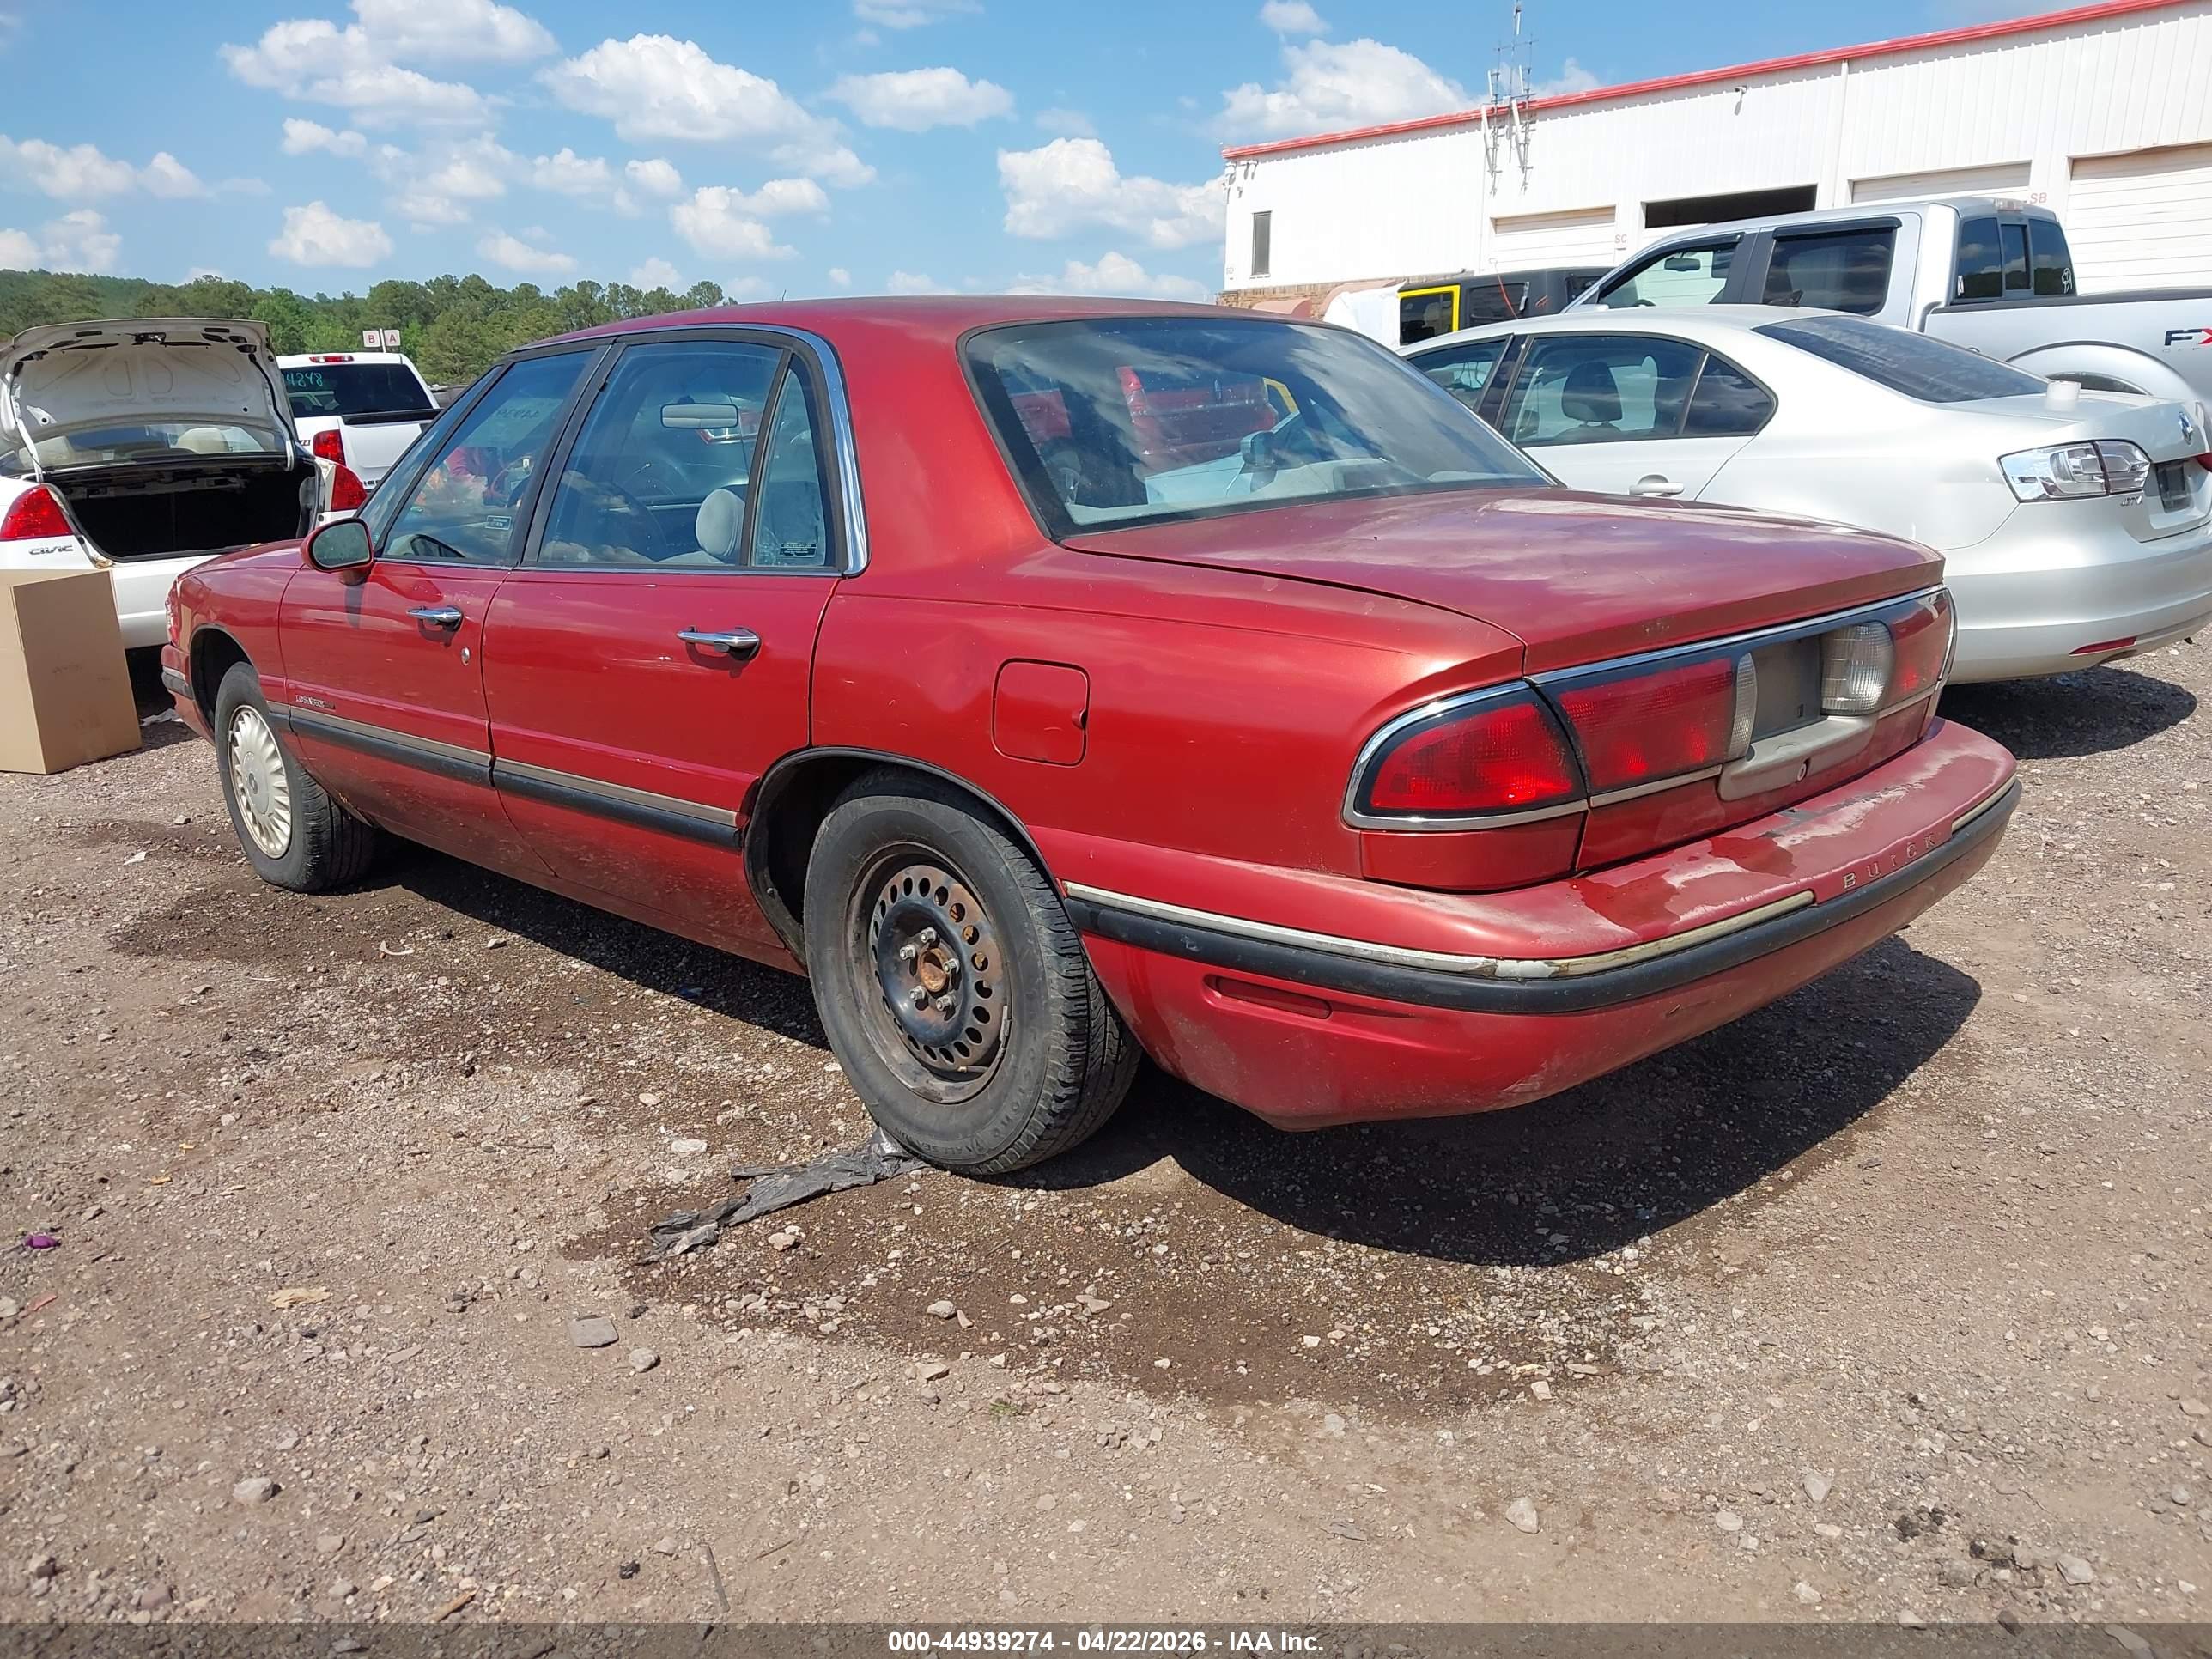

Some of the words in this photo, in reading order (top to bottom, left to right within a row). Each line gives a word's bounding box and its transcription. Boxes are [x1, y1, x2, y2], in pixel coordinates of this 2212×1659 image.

[2030, 192, 2048, 204] SB
[1614, 234, 1627, 244] SC
[368, 335, 375, 343] B
[389, 334, 397, 343] A
[281, 372, 323, 387] 4848
[28, 544, 74, 555] CIVIC
[1843, 833, 1936, 890] BUICK
